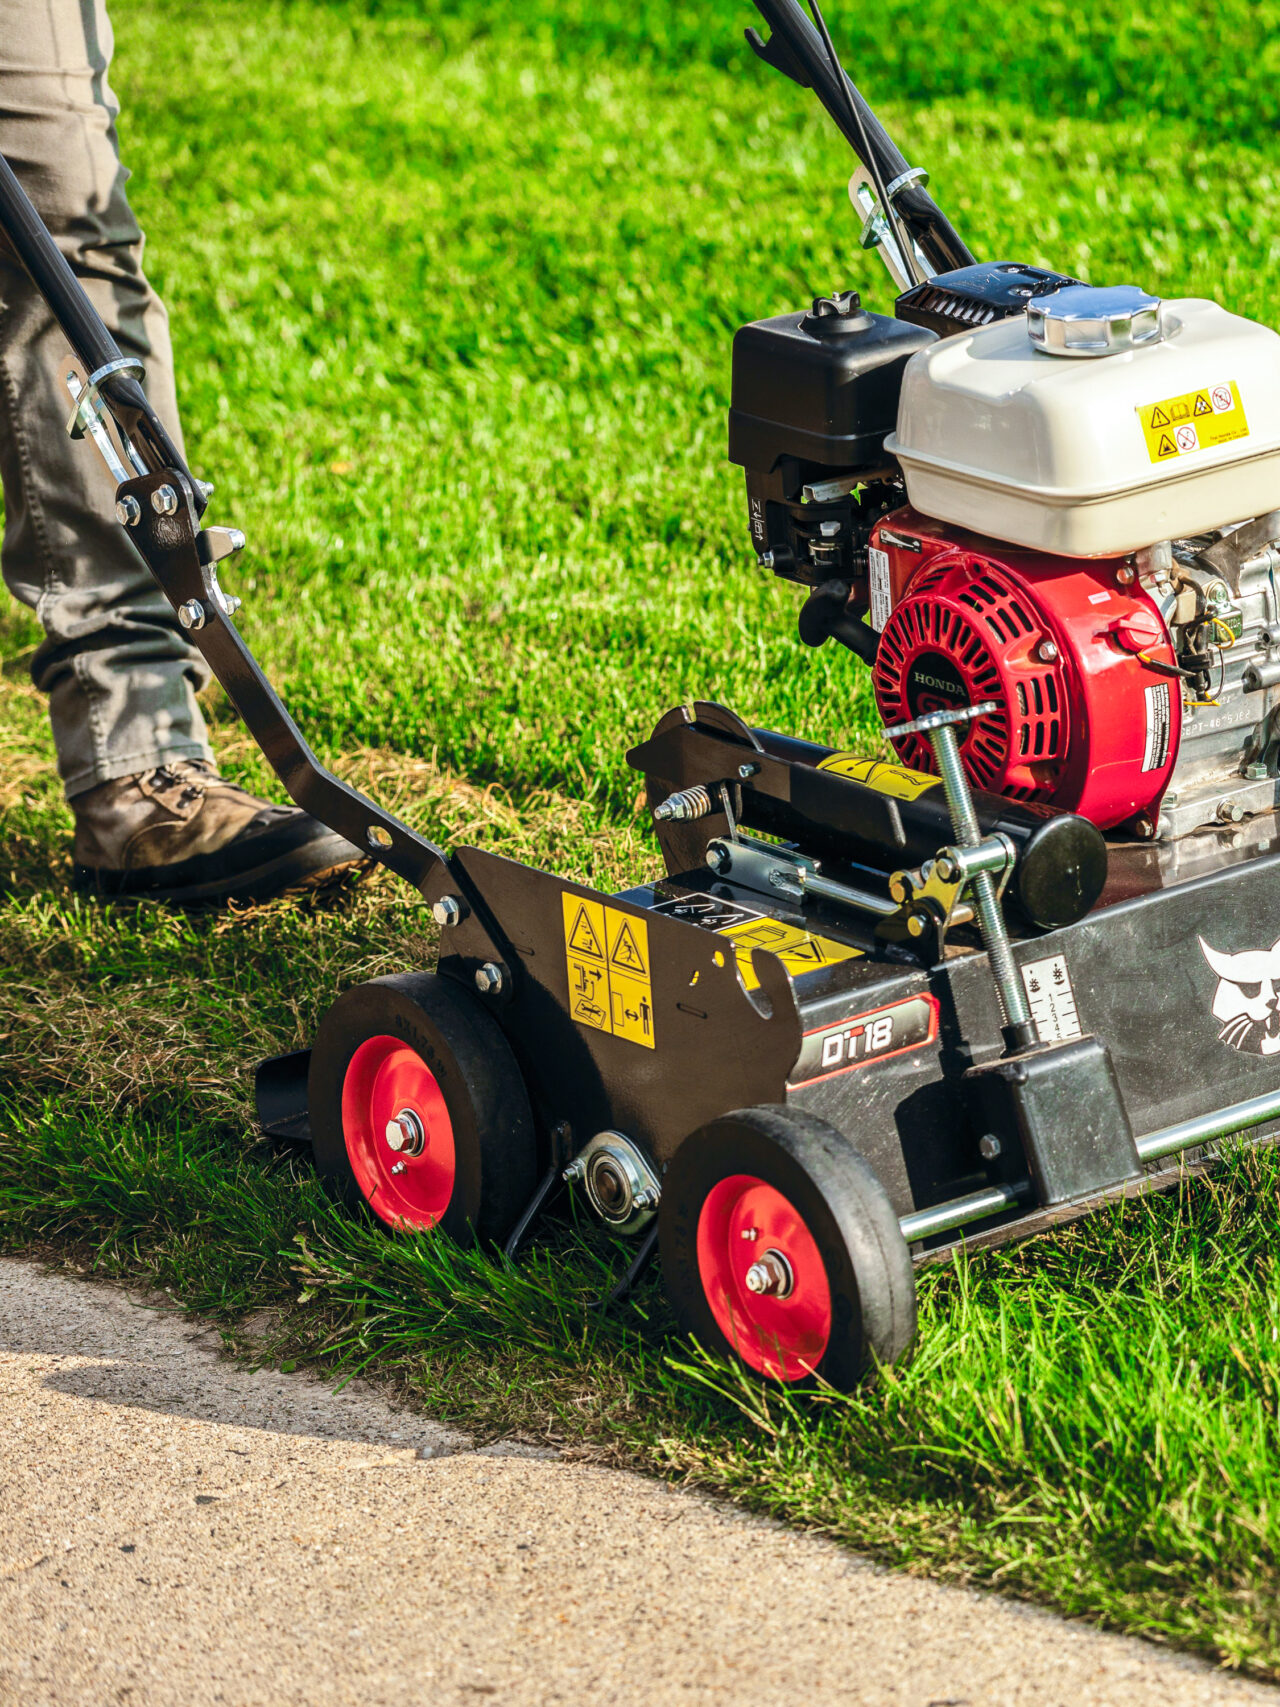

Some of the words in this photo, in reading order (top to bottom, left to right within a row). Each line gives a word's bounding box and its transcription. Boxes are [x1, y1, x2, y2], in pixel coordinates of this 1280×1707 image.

[914, 671, 966, 697] HONDA
[1048, 993, 1053, 1002] 1
[1049, 1003, 1056, 1012] 2
[1051, 1013, 1058, 1022] 3
[1055, 1023, 1060, 1031] 4
[821, 1016, 894, 1068] DT18
